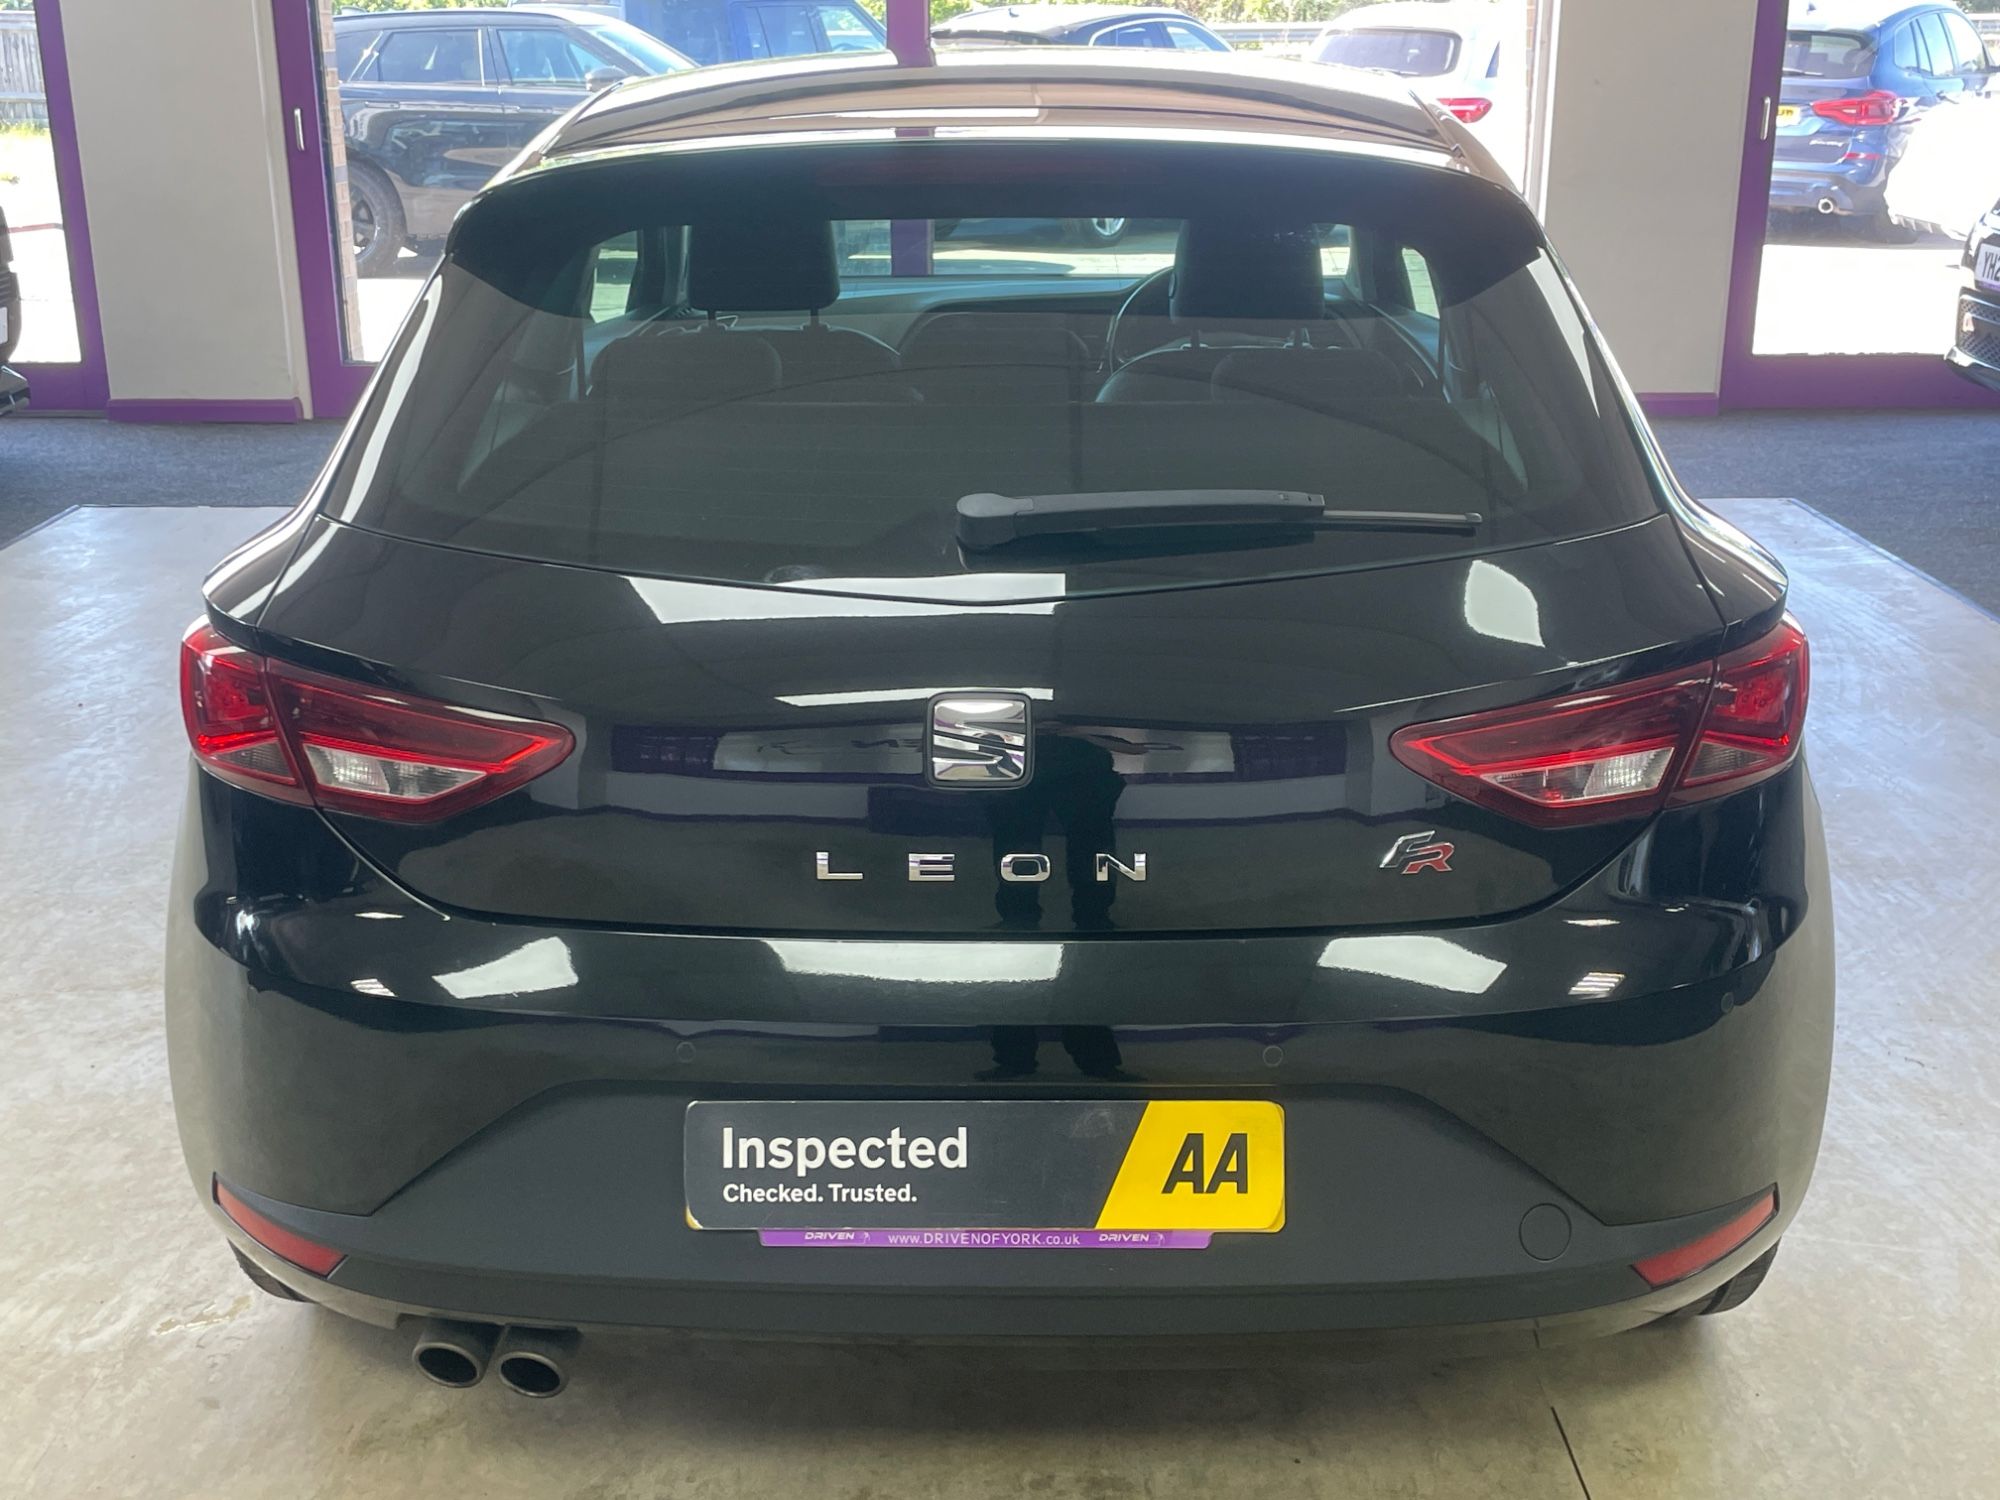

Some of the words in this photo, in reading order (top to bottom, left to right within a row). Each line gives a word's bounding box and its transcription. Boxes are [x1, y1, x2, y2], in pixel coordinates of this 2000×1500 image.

[815, 851, 1147, 882] LEON
[1379, 830, 1455, 874] FR
[722, 1127, 968, 1177] Inspected
[1161, 1132, 1248, 1194] AA
[722, 1183, 824, 1202] Checked.
[828, 1183, 918, 1202] Trusted.
[804, 1231, 855, 1241] DRIVEN
[888, 1232, 1080, 1245] www.DRIVENOFYORK.co.uk
[1099, 1232, 1150, 1242] DRIVEN
